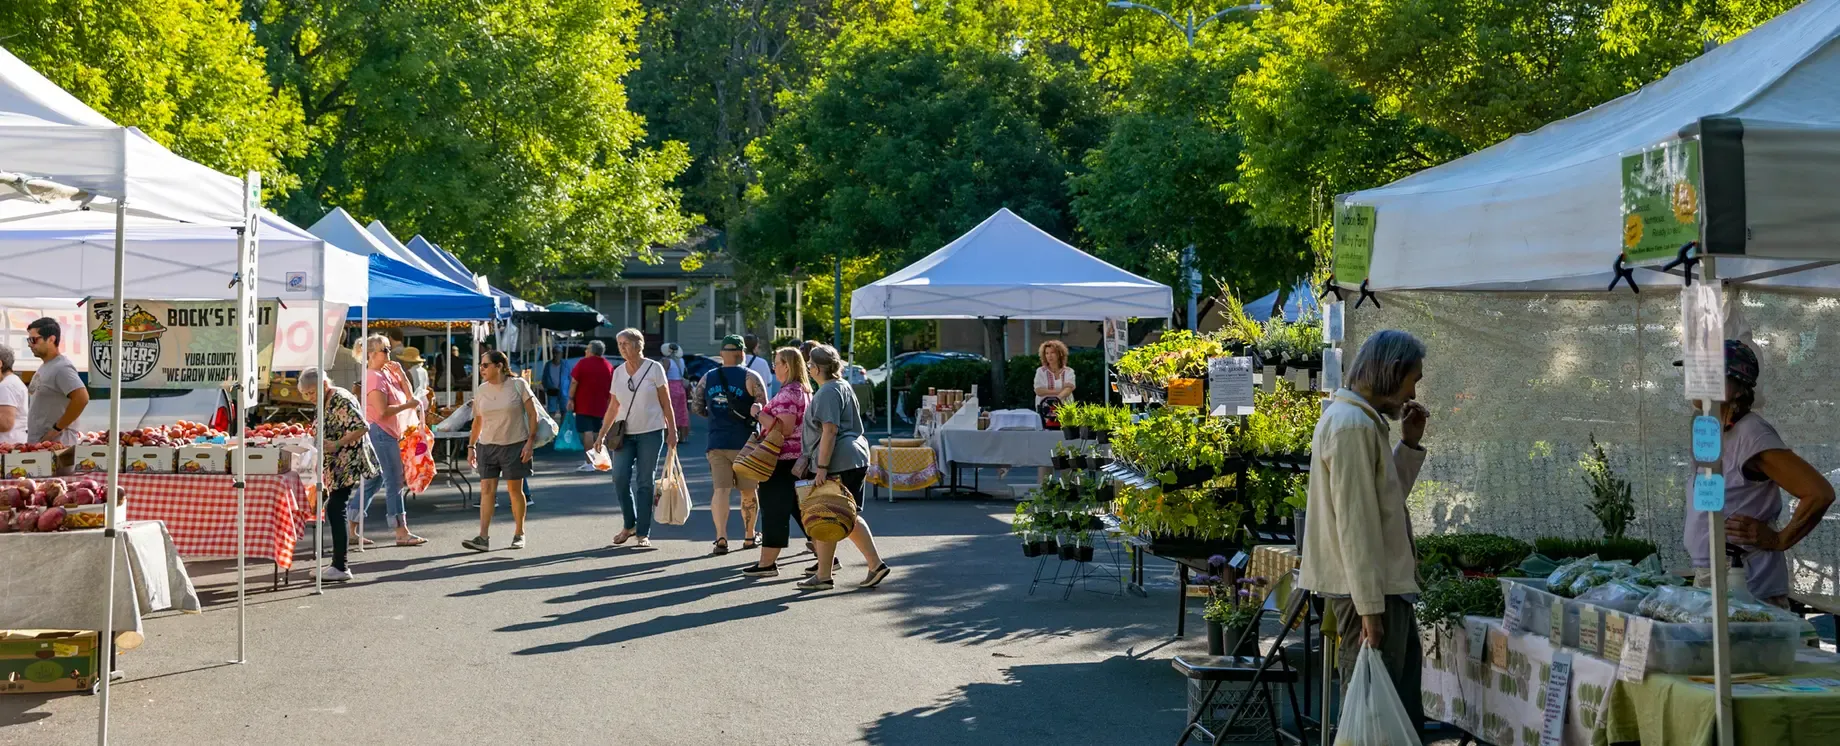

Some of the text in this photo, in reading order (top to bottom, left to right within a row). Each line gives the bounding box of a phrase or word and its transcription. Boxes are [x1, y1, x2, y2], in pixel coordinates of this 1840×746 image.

[248, 213, 257, 399] ORGANIC
[167, 307, 271, 326] BOCK'S FIT
[95, 346, 155, 362] FAMERS
[185, 353, 205, 366] YUBA
[100, 360, 149, 376] MRKET
[181, 368, 206, 382] GROW
[207, 367, 230, 381] WHAT
